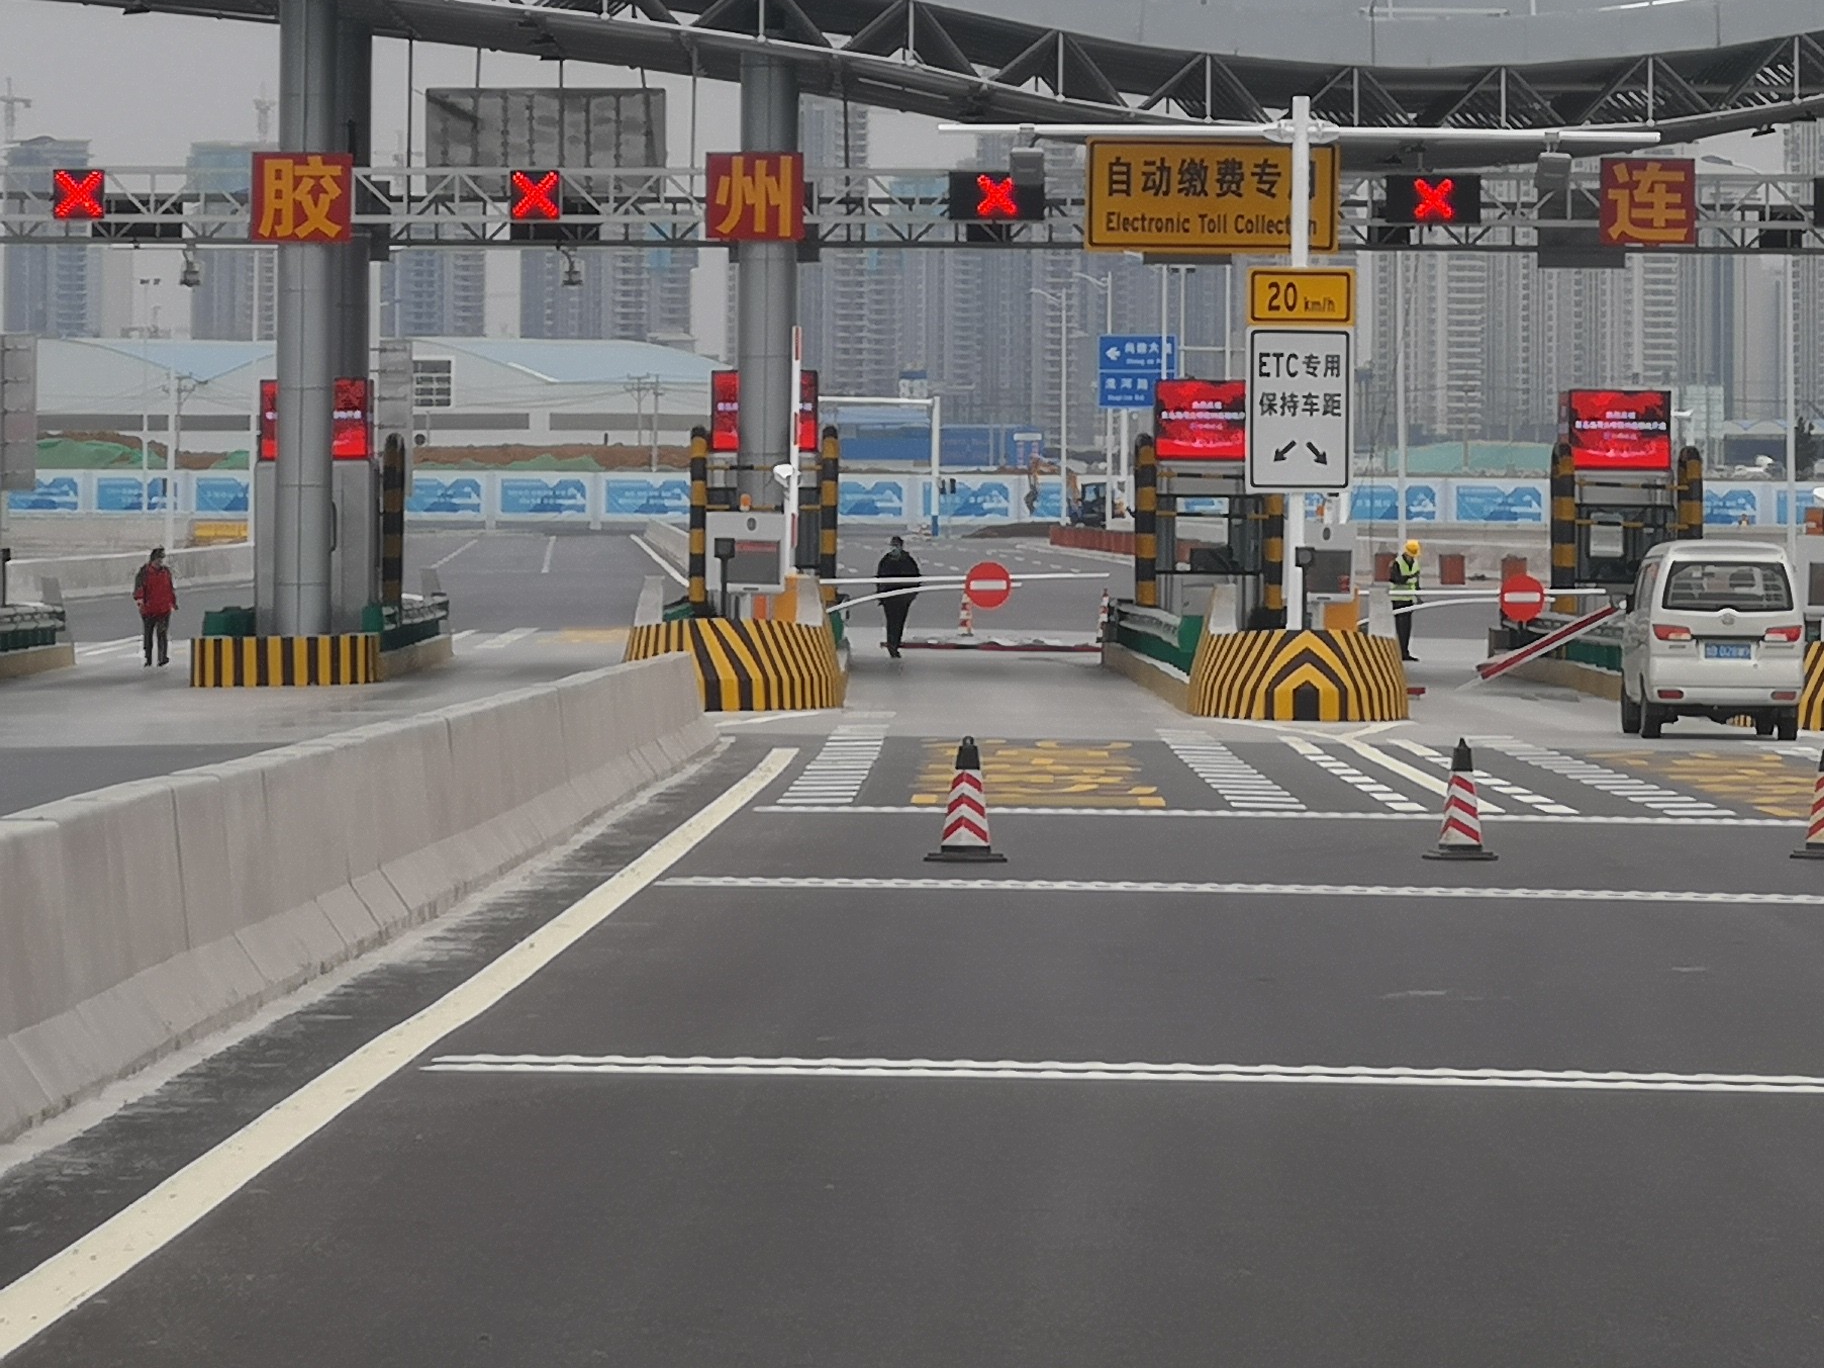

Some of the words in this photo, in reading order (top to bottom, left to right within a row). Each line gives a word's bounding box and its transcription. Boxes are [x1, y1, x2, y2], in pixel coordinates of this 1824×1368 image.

[1108, 157, 1315, 200] 自动缴费专
[259, 157, 342, 239] 胶
[716, 156, 796, 237] 州
[1608, 162, 1689, 243] 连
[1106, 212, 1190, 233] Electronic
[1198, 214, 1227, 234] Toll
[1234, 215, 1317, 236] Collectn
[1267, 281, 1297, 312] 20
[1304, 297, 1336, 312] km/h
[1259, 392, 1342, 417] 保持车距
